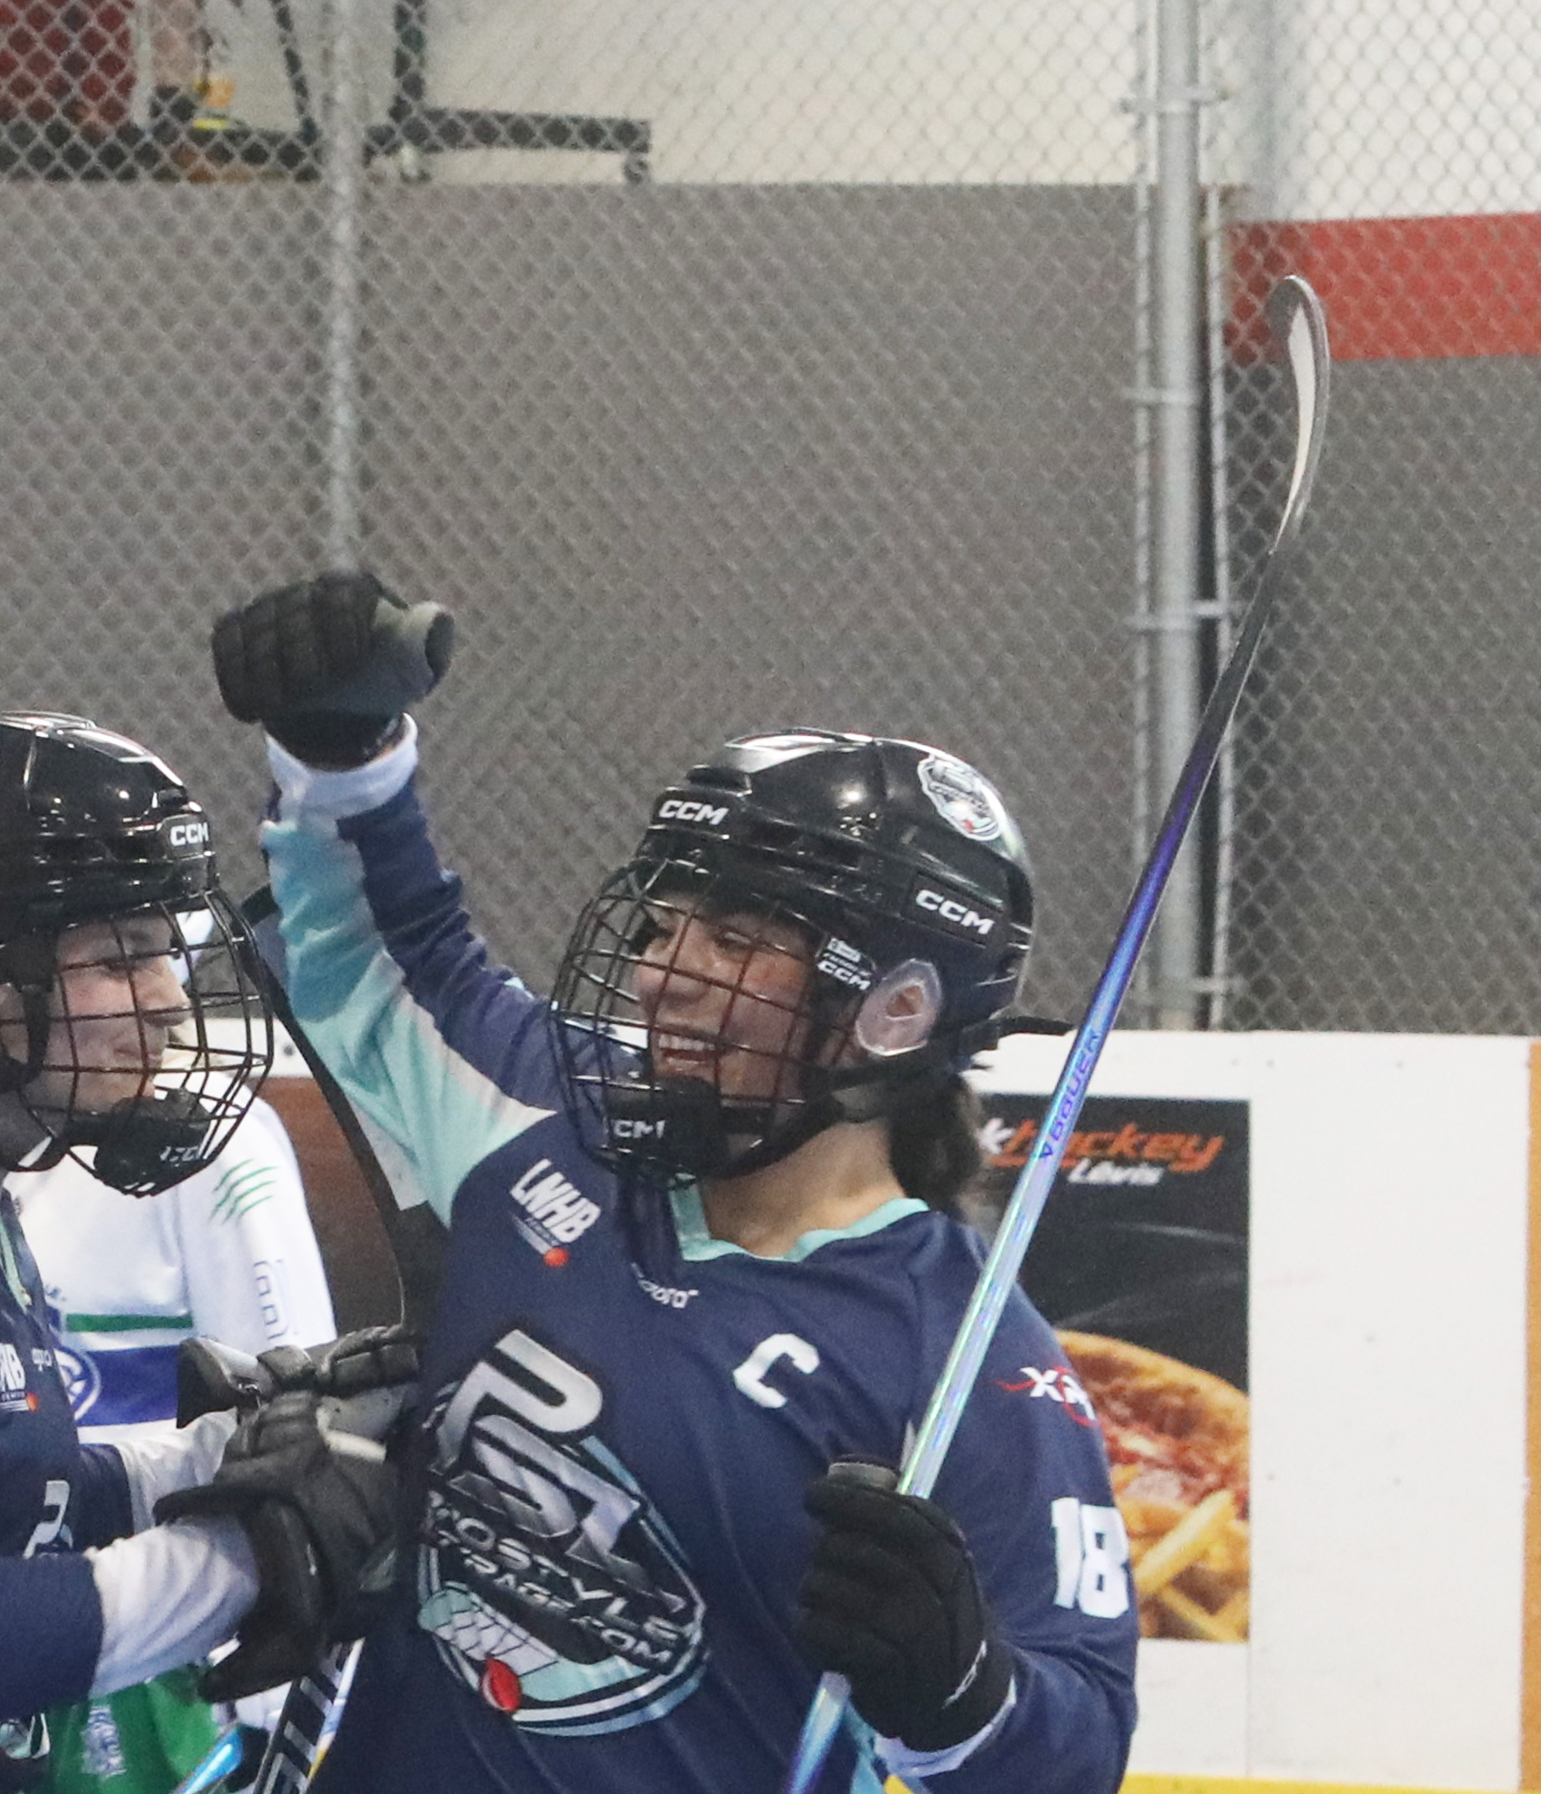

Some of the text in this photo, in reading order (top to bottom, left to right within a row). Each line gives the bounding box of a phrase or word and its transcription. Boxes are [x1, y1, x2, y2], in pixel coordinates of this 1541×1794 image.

[659, 799, 729, 826] CCM
[171, 822, 209, 847] CCM
[915, 889, 996, 935] CCM
[817, 959, 871, 991] CCM
[611, 1118, 666, 1139] CM
[510, 1157, 602, 1243] LNHB
[733, 1333, 820, 1409] C
[1051, 1496, 1130, 1619] 18
